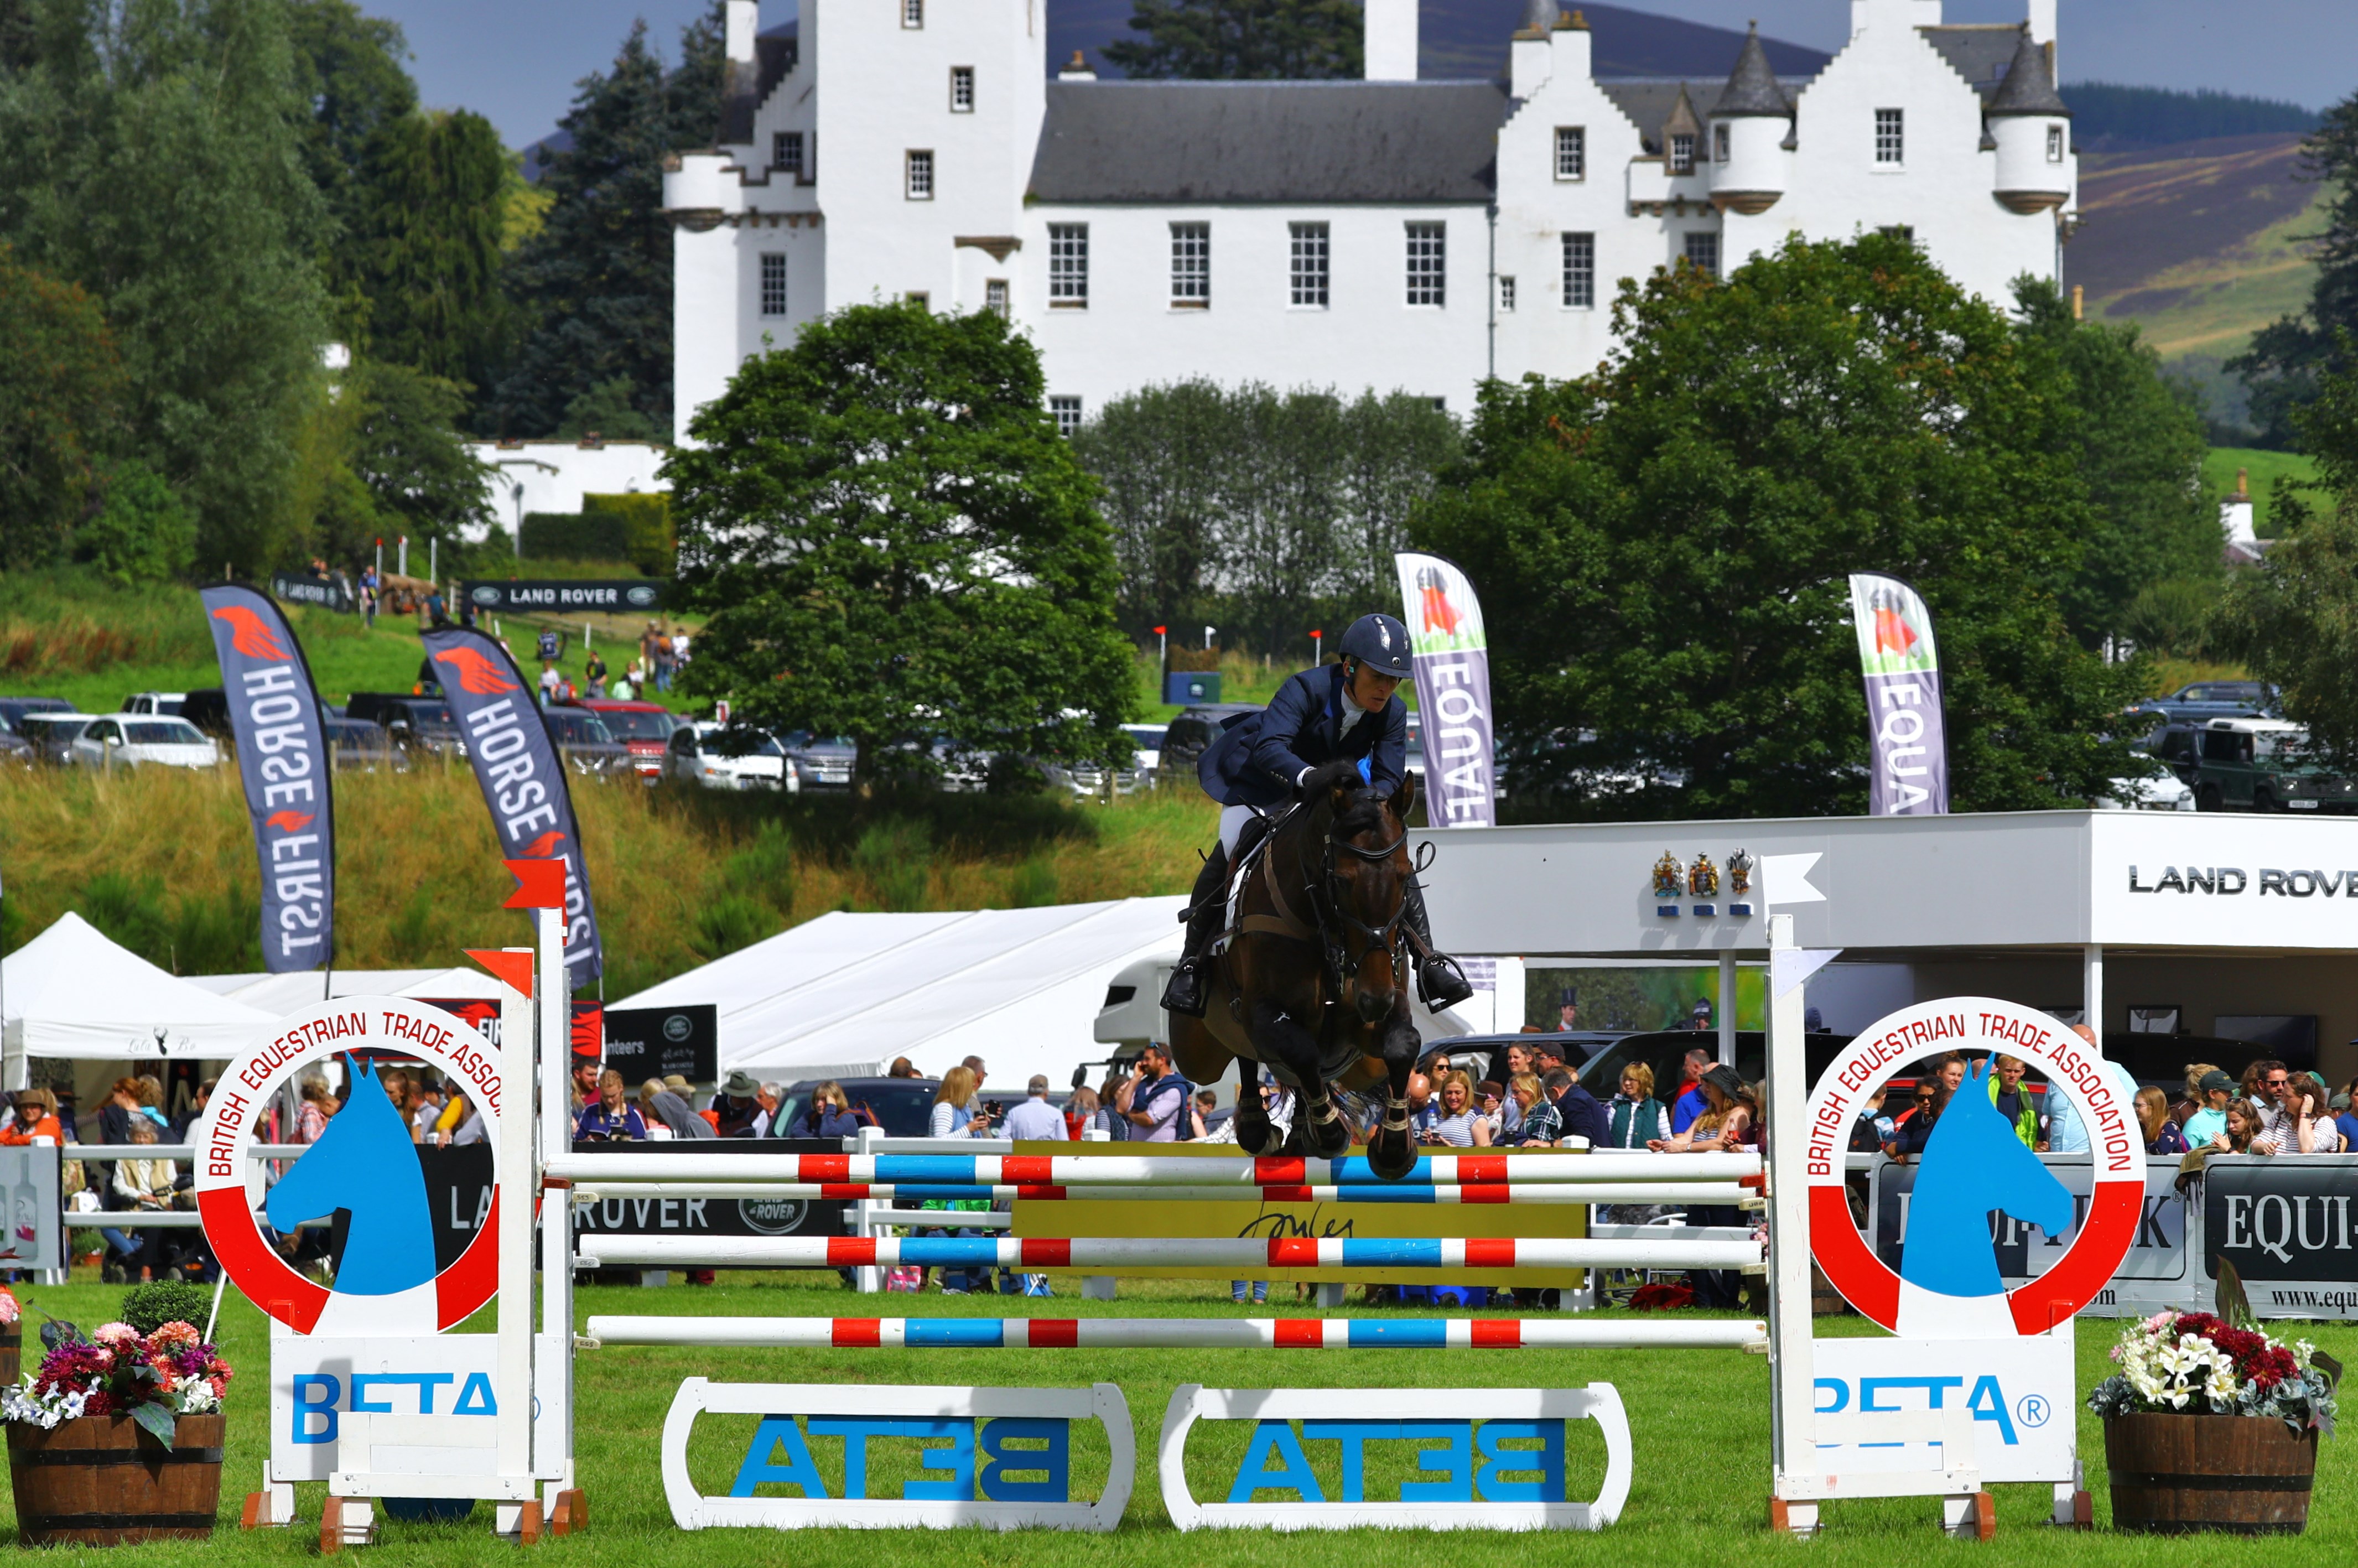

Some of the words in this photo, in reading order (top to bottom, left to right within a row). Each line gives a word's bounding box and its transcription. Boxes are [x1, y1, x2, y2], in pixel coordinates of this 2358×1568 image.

[510, 589, 555, 604] LAND
[560, 589, 618, 604] ROVER
[466, 698, 557, 842] HORSE
[1878, 683, 1929, 814] EQUA
[2128, 865, 2247, 895] LAND
[209, 1092, 250, 1177] BRITISH
[238, 1012, 367, 1091] EQUESTRIAN
[382, 1011, 454, 1055] TRADE
[448, 1043, 501, 1118] ASSOC
[1808, 1091, 1850, 1176] BRITISH
[1838, 1014, 1965, 1093] EQUESTRIAN
[1979, 1013, 2051, 1052] TRADE
[2047, 1042, 2132, 1171] ASSOCIATION
[756, 1204, 795, 1219] ROVER
[291, 1372, 498, 1444] BETA
